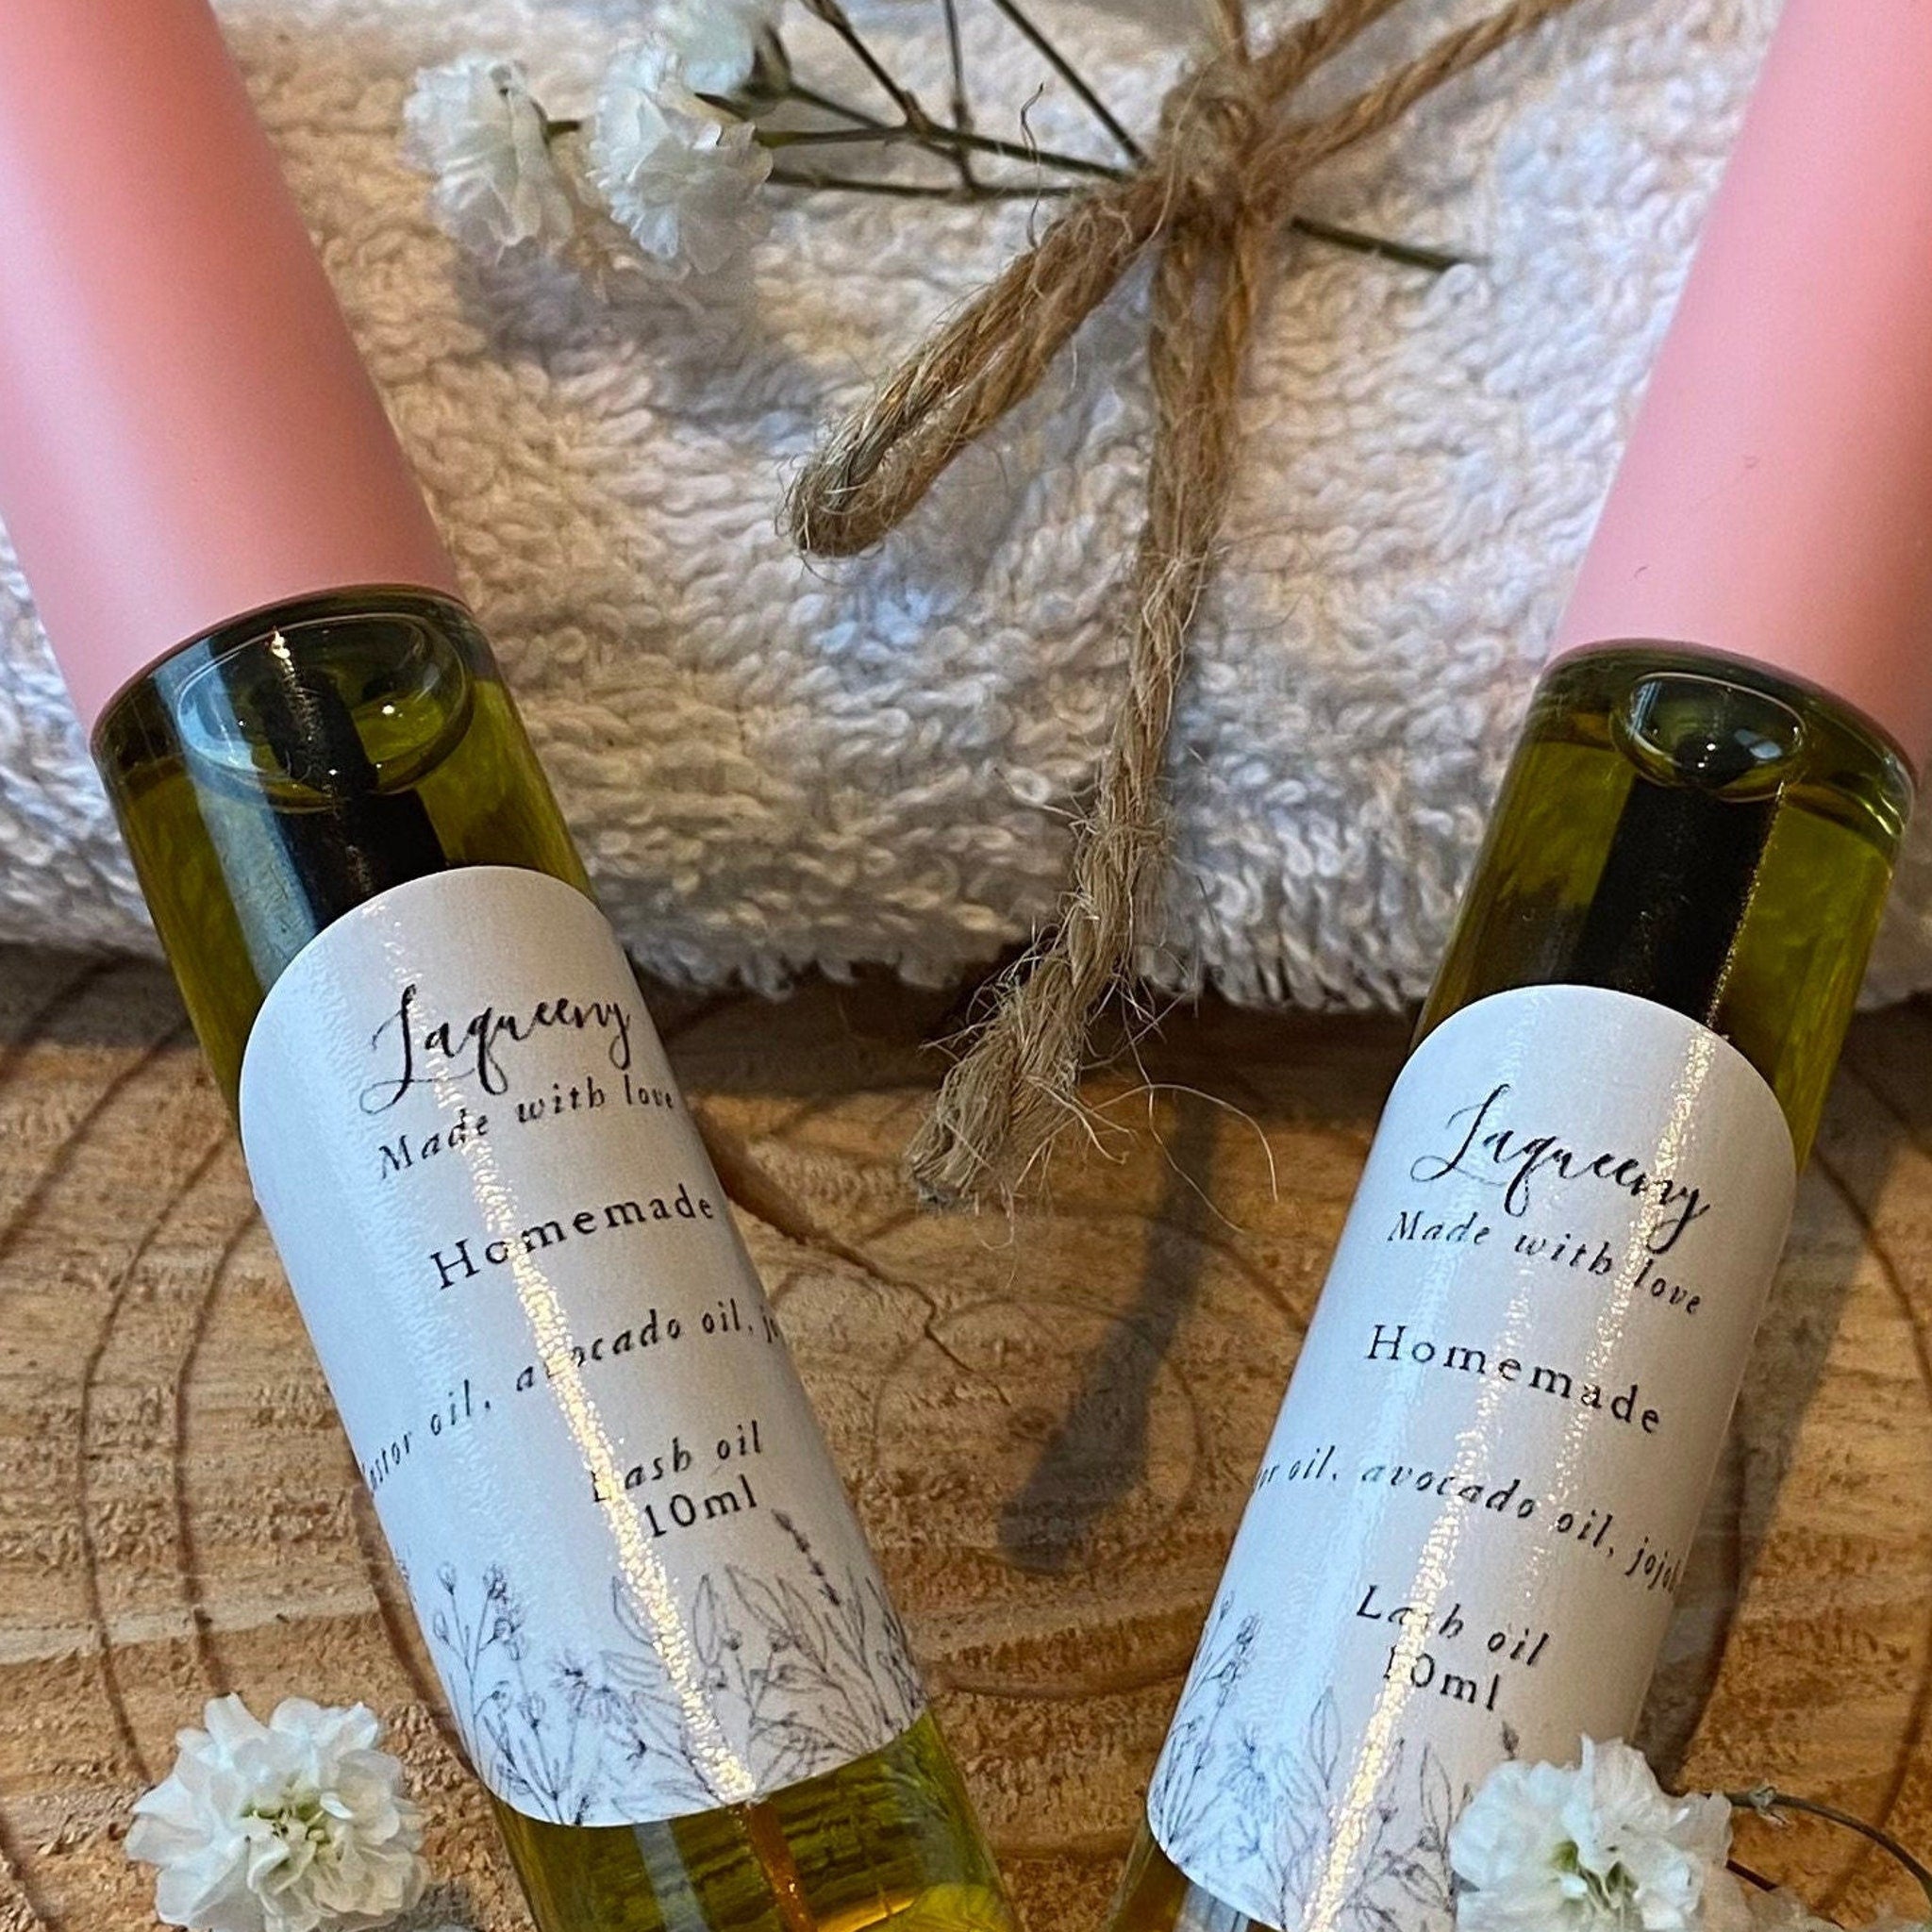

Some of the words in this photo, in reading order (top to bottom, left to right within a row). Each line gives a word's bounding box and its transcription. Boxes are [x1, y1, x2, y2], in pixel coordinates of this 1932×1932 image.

[378, 1108, 489, 1179] Made
[517, 1075, 606, 1123] with
[624, 1074, 674, 1109] love
[430, 1184, 714, 1291] Homemade
[1387, 1210, 1491, 1246] Made
[1514, 1232, 1614, 1277] with
[1633, 1257, 1702, 1317] love
[1365, 1324, 1660, 1435] Homemade
[716, 1420, 762, 1460] oil
[644, 1474, 758, 1538] 10ml
[1361, 1464, 1536, 1519] avocado
[1383, 1644, 1501, 1712] 10ml
[1487, 1627, 1551, 1667] oil
